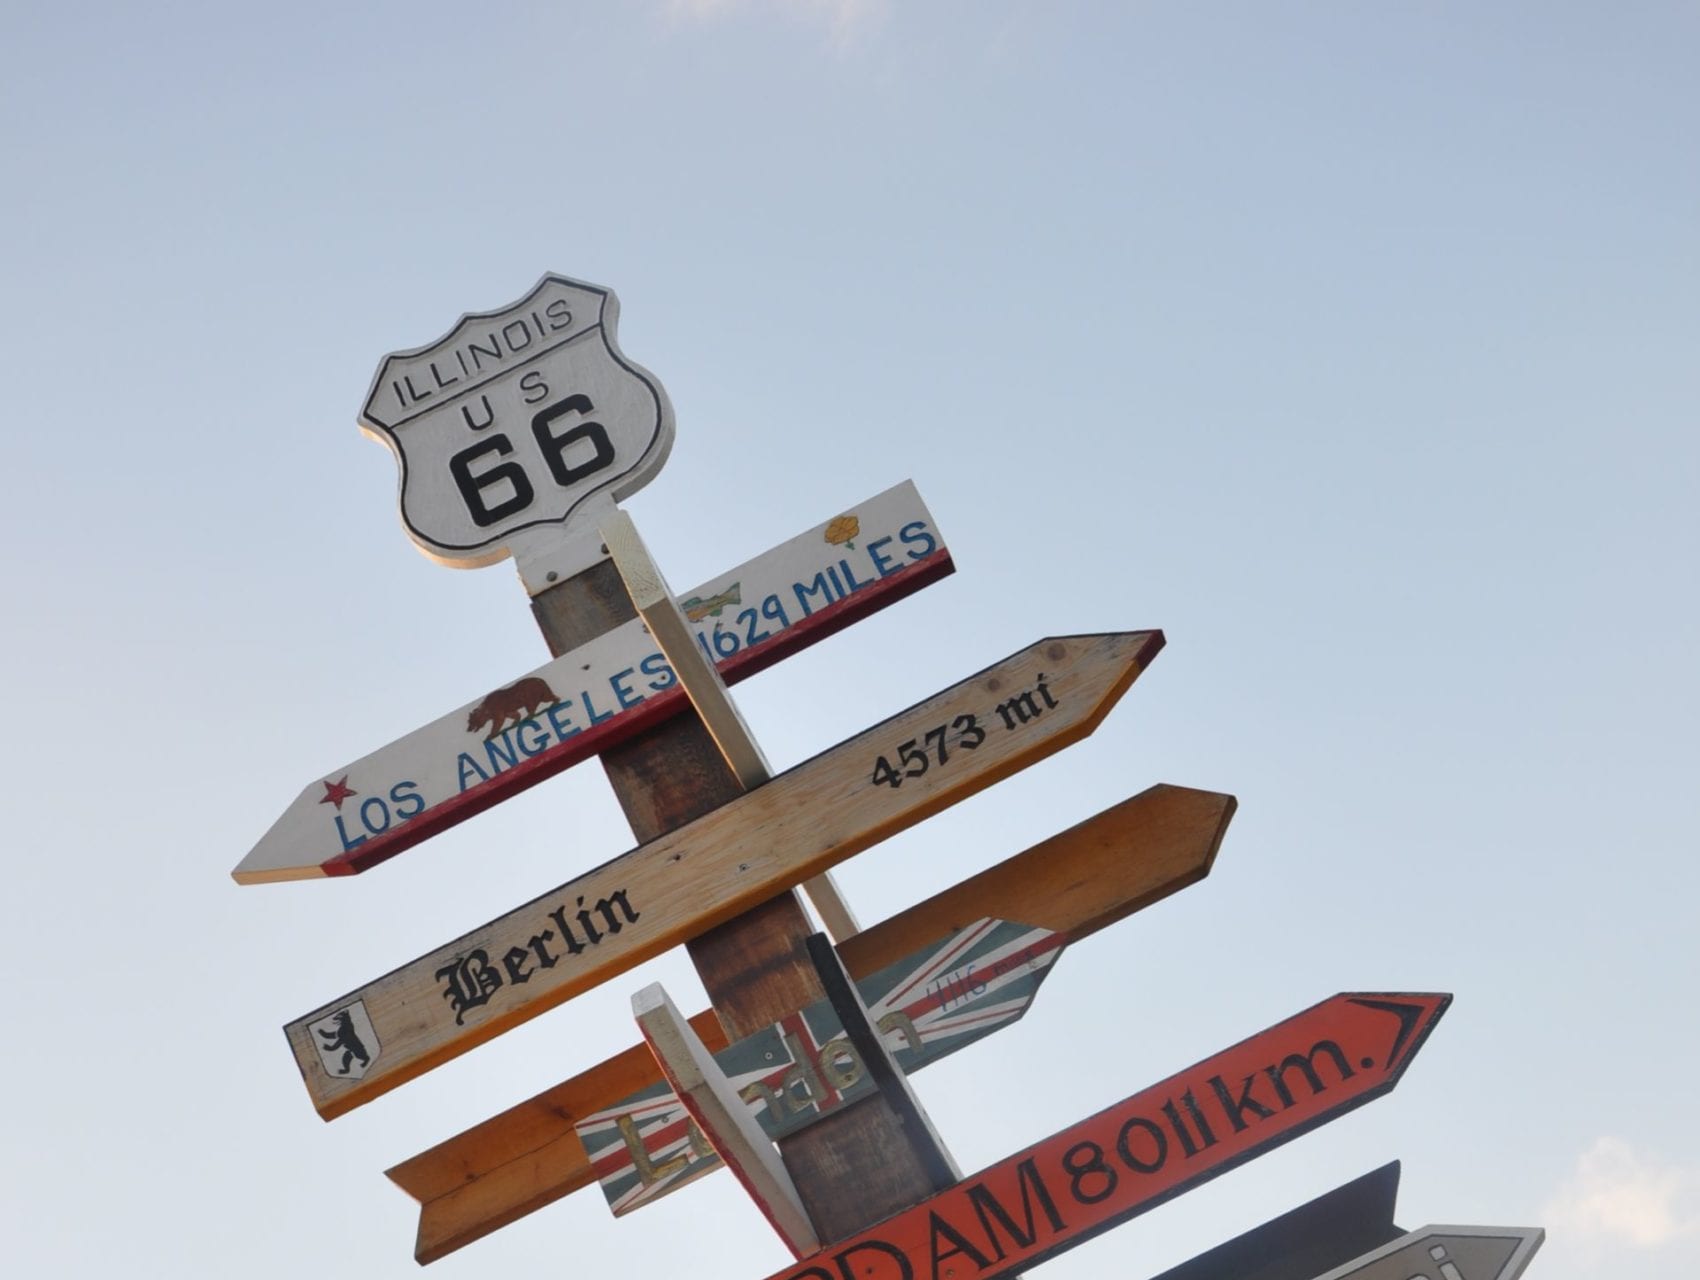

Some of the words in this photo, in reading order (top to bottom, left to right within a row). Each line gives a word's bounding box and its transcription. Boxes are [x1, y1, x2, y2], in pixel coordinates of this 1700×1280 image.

[393, 299, 573, 407] ILLINOIS
[461, 394, 494, 431] U
[519, 371, 549, 404] S
[449, 393, 616, 527] 66
[334, 780, 426, 851] LOS
[456, 652, 678, 792] ANGELES
[697, 593, 790, 664] 1629
[792, 521, 937, 618] MILES
[434, 888, 640, 1026] Berlin
[871, 713, 986, 788] 4573
[995, 672, 1060, 730] mi
